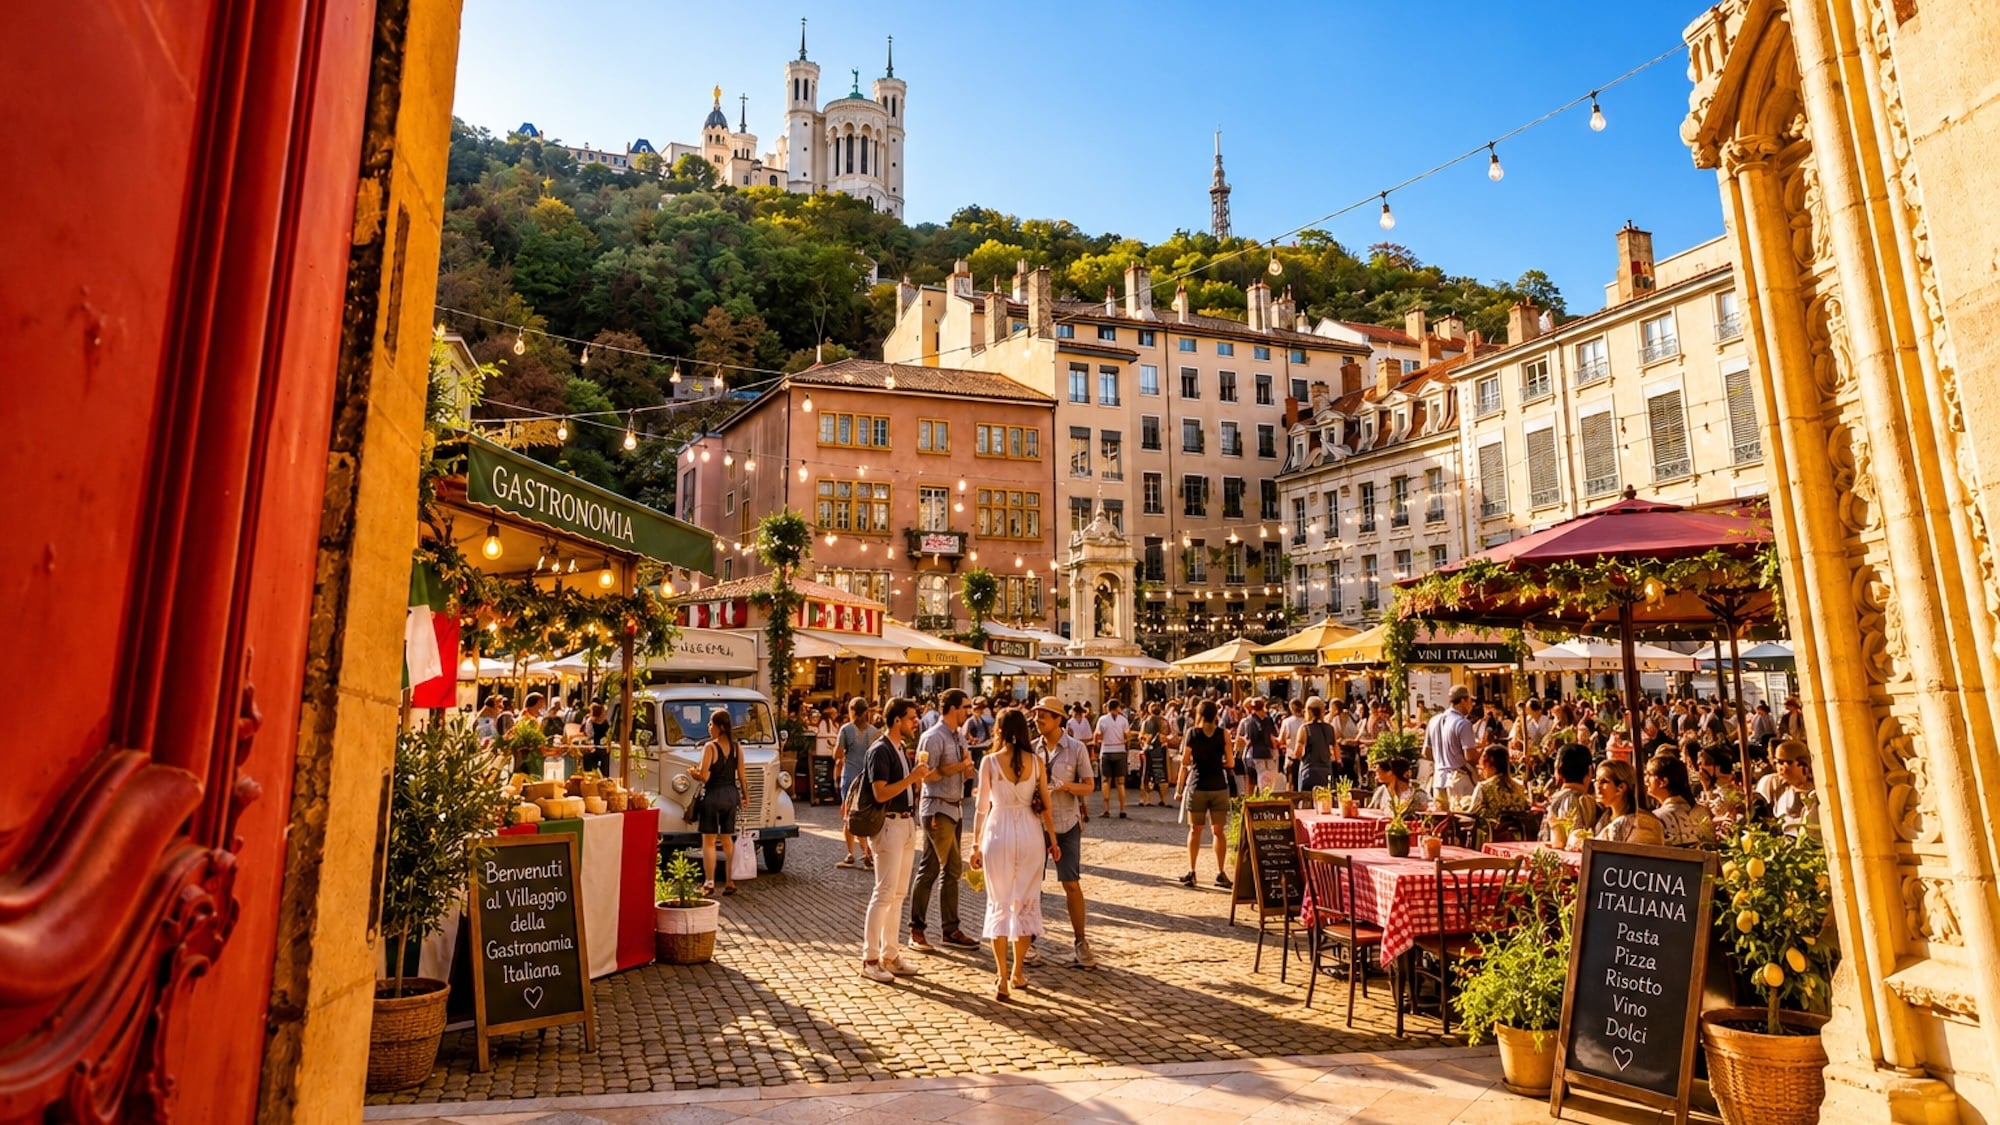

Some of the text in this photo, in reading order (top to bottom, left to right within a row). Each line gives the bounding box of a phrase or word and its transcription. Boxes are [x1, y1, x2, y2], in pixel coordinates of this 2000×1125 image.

[492, 465, 635, 544] GASTRONOMIA
[1417, 649, 1497, 660] VINI ITALIANI
[485, 859, 563, 884] Benvenuti
[1603, 867, 1687, 897] CUCINA
[486, 886, 567, 911] al Villaggio
[1597, 892, 1687, 922] ITALIANA
[510, 912, 546, 933] della
[1616, 922, 1660, 946] Pasta
[486, 934, 573, 960] Gastronomia
[1614, 946, 1657, 970] Pizza
[503, 961, 562, 984] Italiana
[1605, 968, 1663, 996] Risotto
[1612, 994, 1647, 1018] Vino
[1605, 1017, 1648, 1045] Dolci
